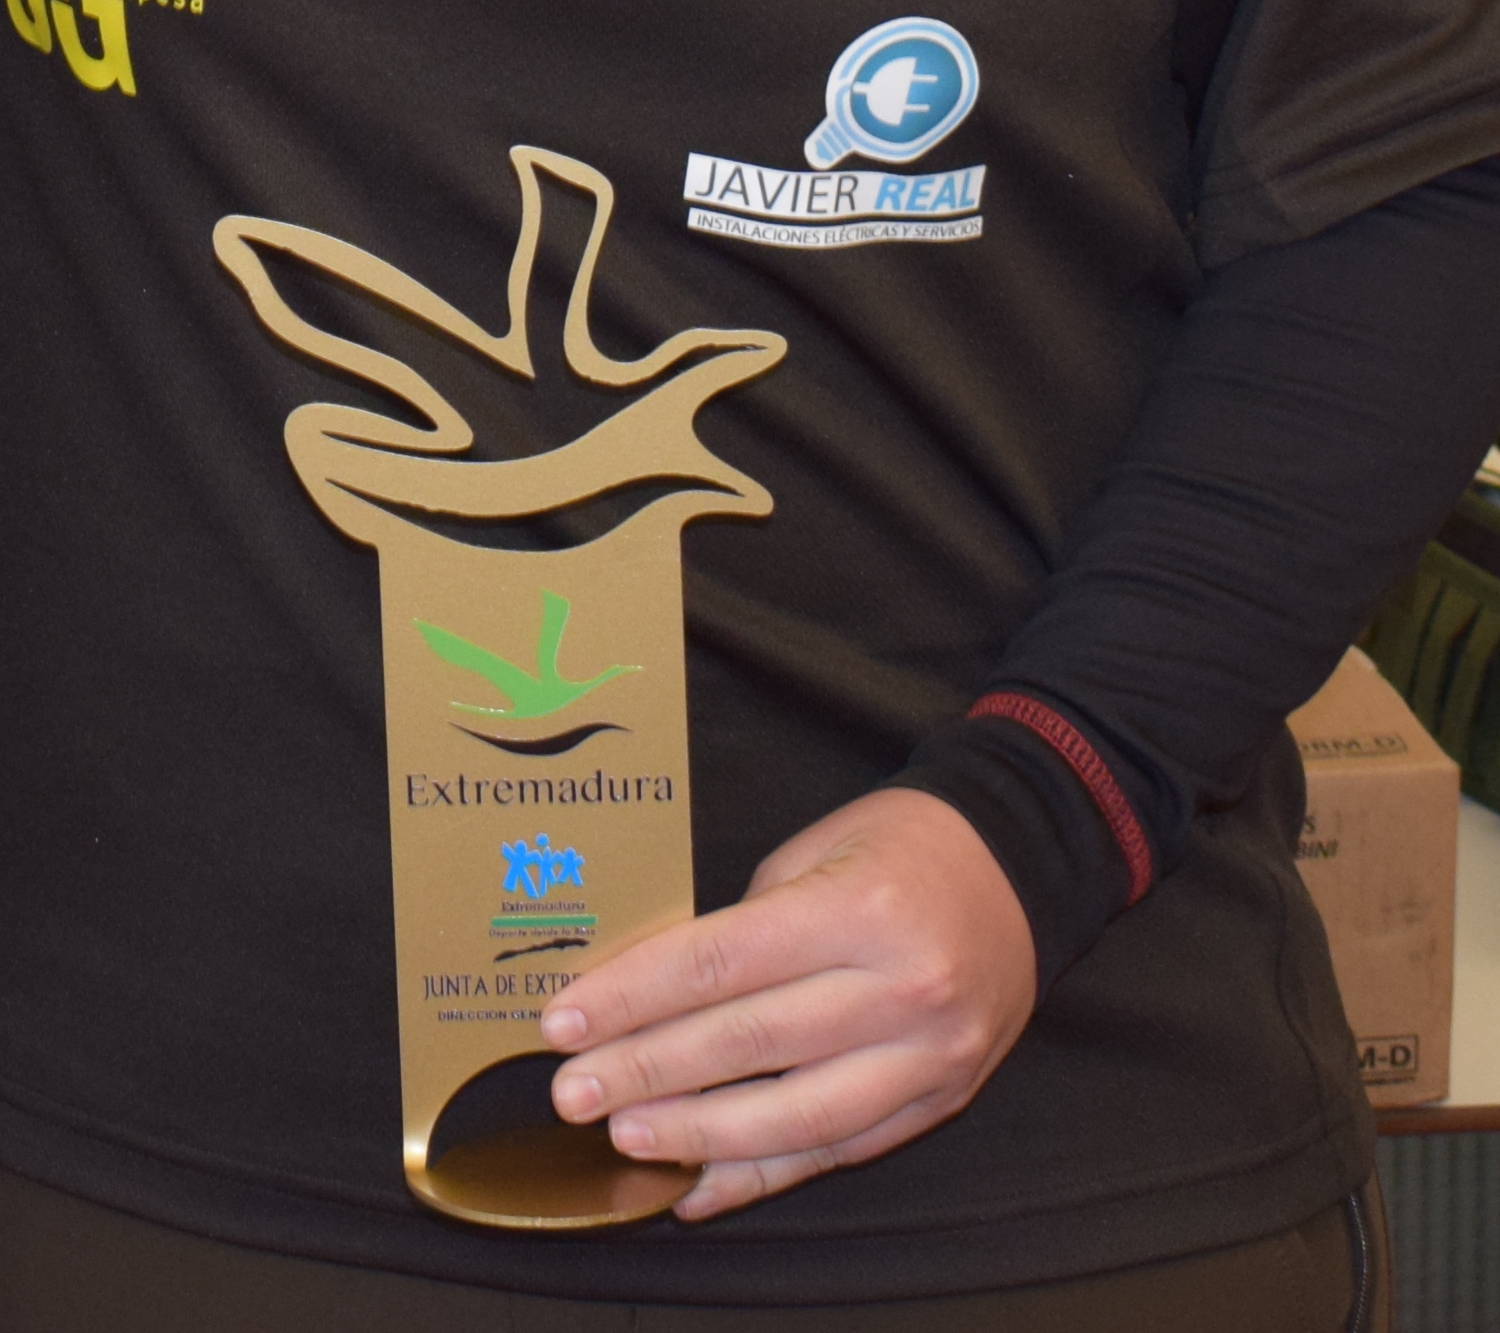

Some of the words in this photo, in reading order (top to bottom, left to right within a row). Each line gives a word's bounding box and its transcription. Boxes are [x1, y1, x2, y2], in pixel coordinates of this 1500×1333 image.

[694, 160, 860, 215] JAVIER
[873, 175, 977, 212] REAL
[696, 213, 821, 244] INSTALACIONES
[901, 224, 912, 238] Y
[914, 219, 981, 239] SERVICIOS
[405, 770, 674, 807] Extremadura
[501, 900, 586, 913] Extremadura
[423, 974, 489, 1001] JUNTA
[496, 974, 519, 997] DE
